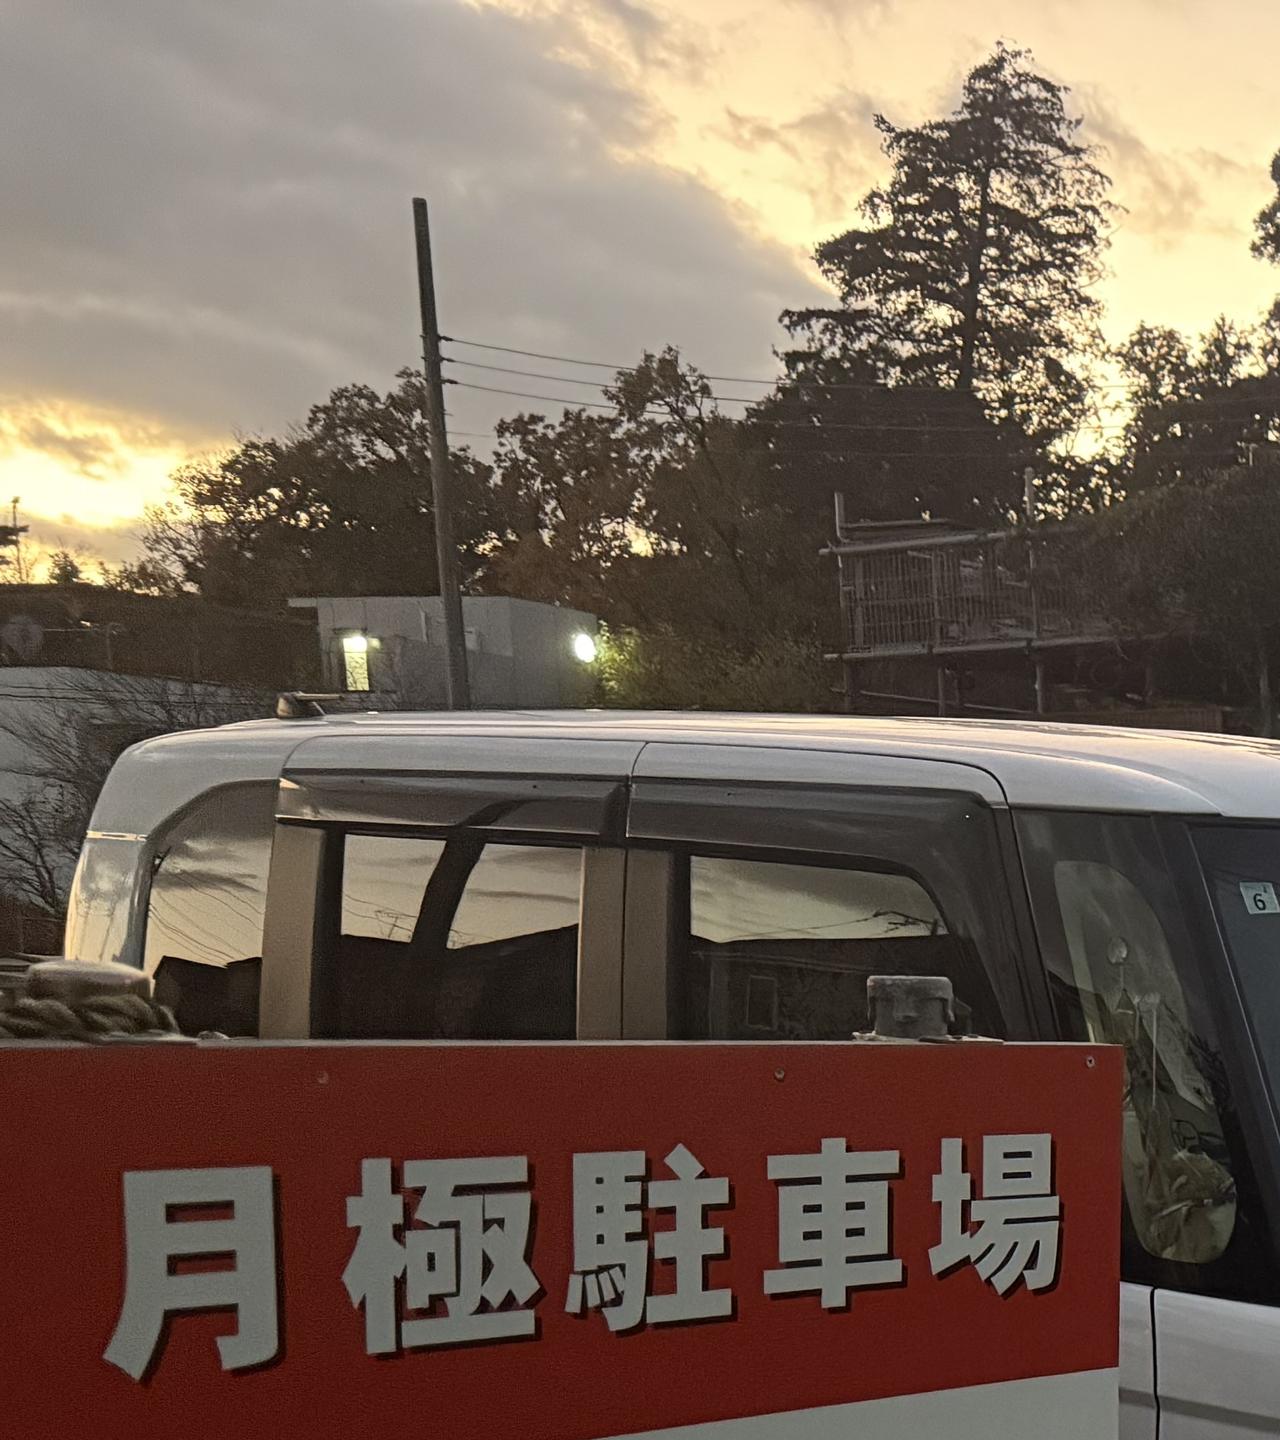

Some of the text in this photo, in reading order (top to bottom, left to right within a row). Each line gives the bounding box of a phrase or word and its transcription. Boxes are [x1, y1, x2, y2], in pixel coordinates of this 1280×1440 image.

[101, 1132, 1064, 1382] 月極駐車場
